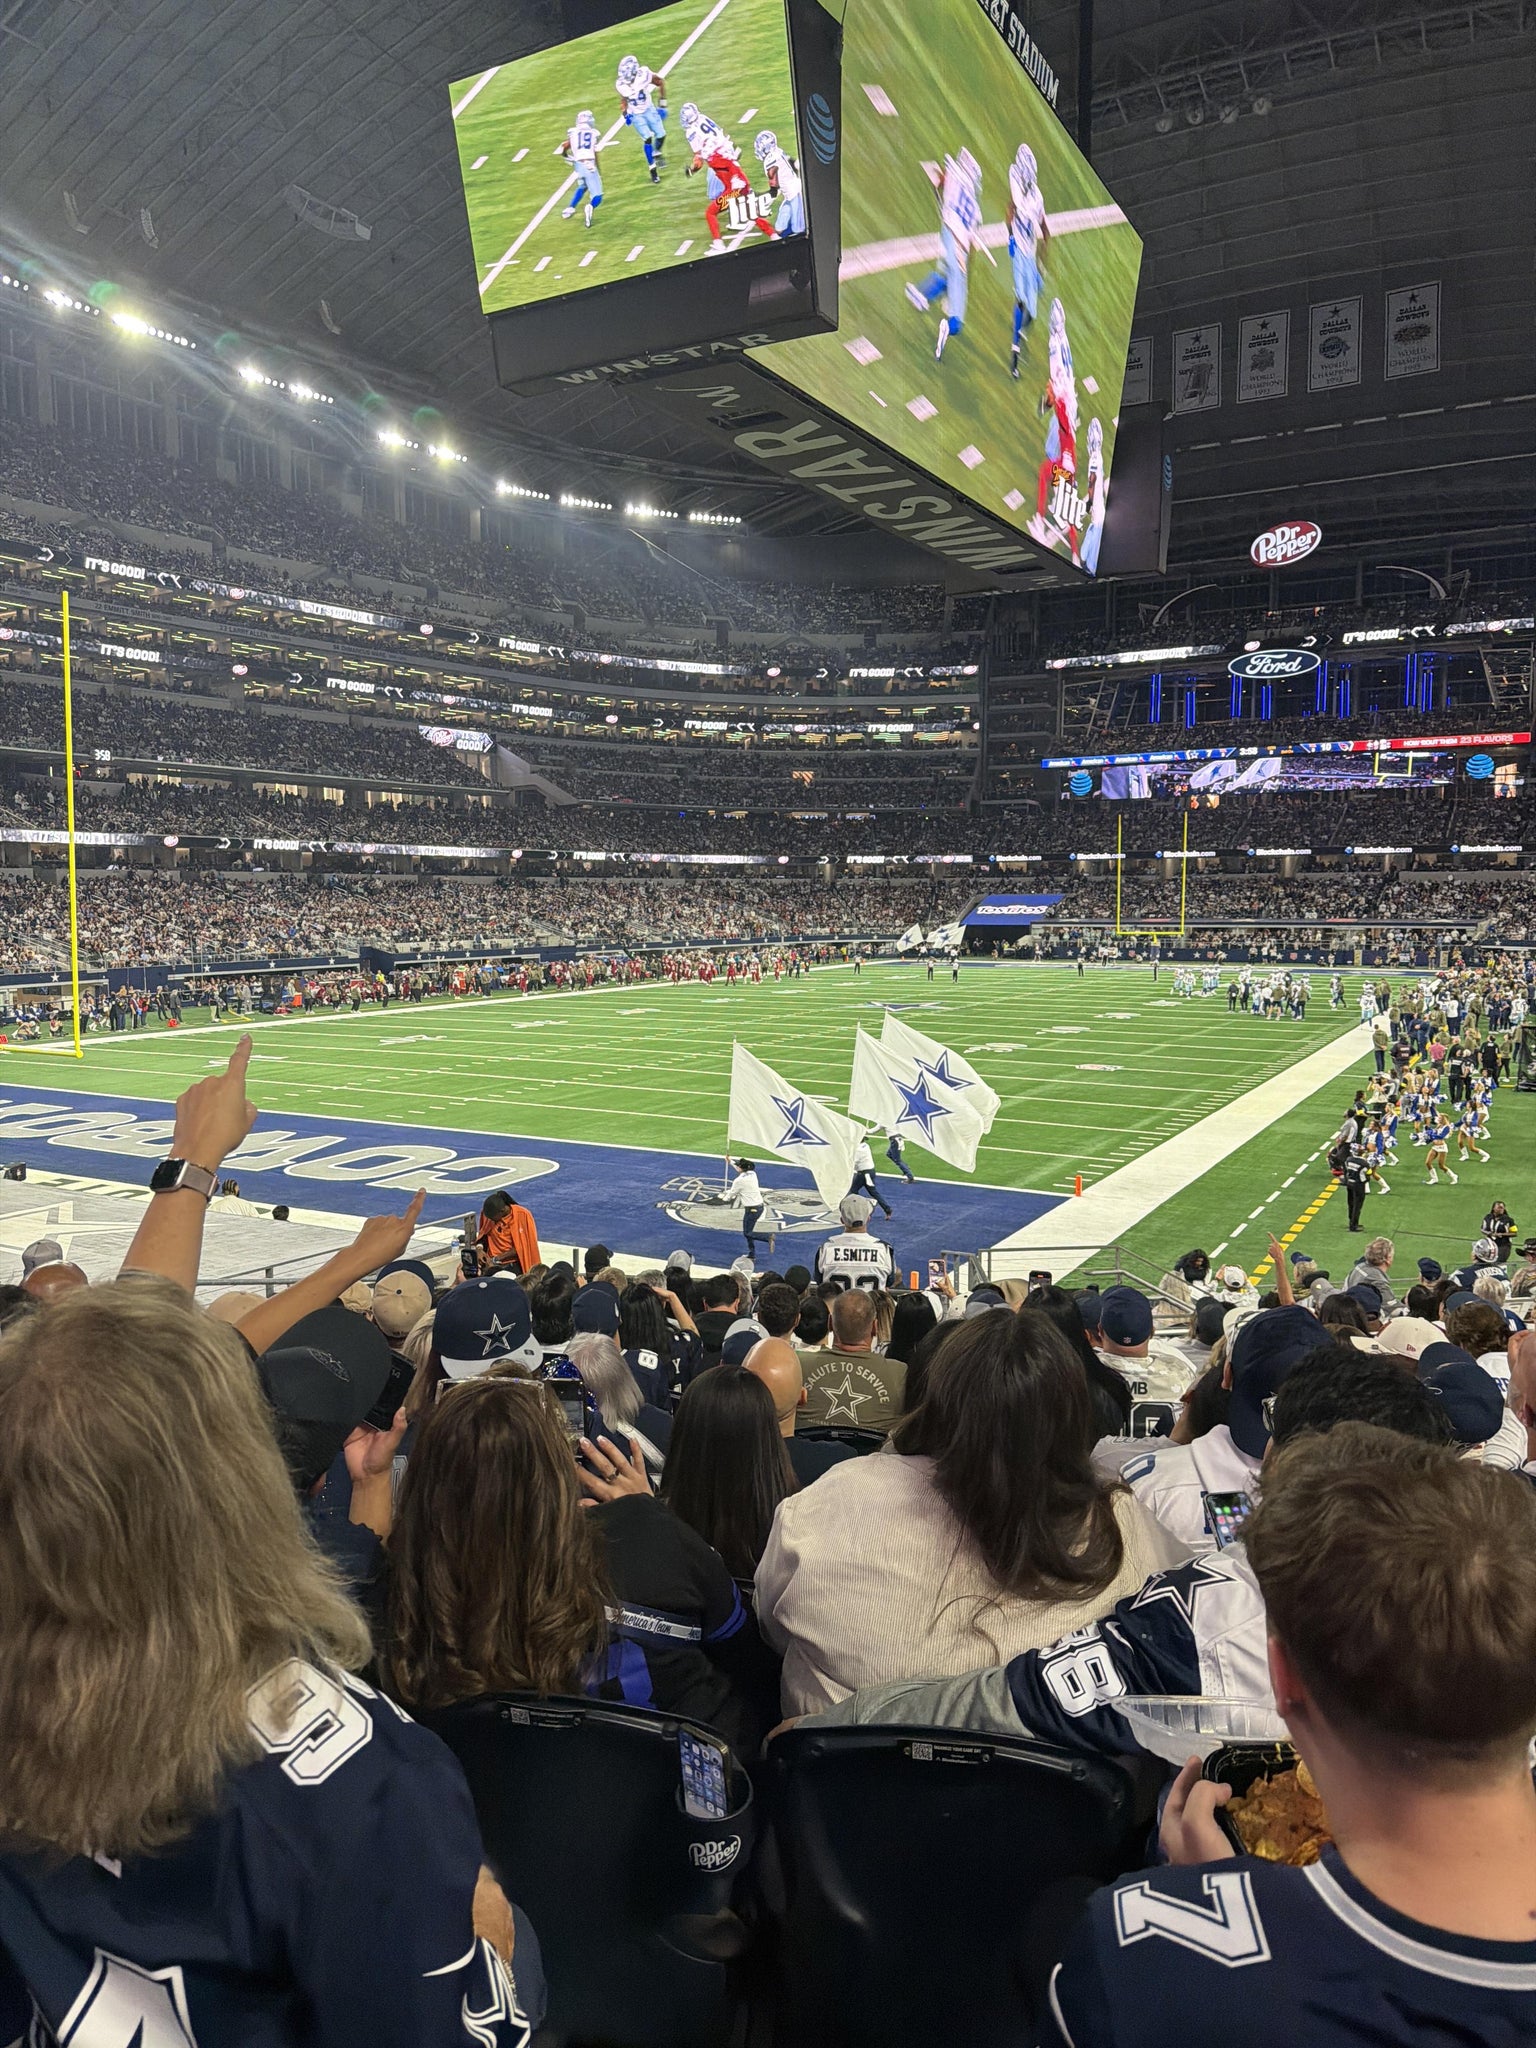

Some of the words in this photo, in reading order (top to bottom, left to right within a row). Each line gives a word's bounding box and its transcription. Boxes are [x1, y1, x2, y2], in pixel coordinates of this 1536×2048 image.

[1007, 11, 1060, 109] STADIUM
[577, 132, 592, 149] 19
[555, 333, 776, 385] WINSTAR
[734, 419, 1038, 570] WINSTAR
[1275, 526, 1300, 545] Dr
[1258, 531, 1316, 563] Pepper
[85, 557, 110, 573] IT'S
[111, 563, 146, 580] GOOD!
[1342, 632, 1366, 644] IT'S
[1366, 628, 1400, 642] GOOD!
[100, 643, 125, 657] IT'S
[126, 647, 161, 662] GOOD!
[499, 637, 516, 649] IT'S
[516, 641, 540, 653] GOOD!
[849, 668, 868, 677] IT'S
[868, 668, 895, 677] GOOD!
[1245, 654, 1301, 674] Ford
[326, 677, 348, 689] IT'S
[348, 680, 375, 694] GOOD!
[512, 704, 529, 713] IT'S
[529, 707, 553, 717] GOOD!
[684, 720, 702, 729] IT'S
[702, 721, 728, 730] GOOD!
[868, 724, 887, 732] IT'S
[887, 723, 914, 732] GOOD!
[456, 740, 483, 751] GOOD!
[1460, 736, 1472, 744] 23
[1473, 734, 1513, 743] FLAVORS
[1239, 747, 1258, 756] 3:58
[1321, 743, 1332, 751] 10
[253, 839, 273, 849] IT'S
[273, 839, 300, 850] GOOD!
[1256, 847, 1312, 856] Blockchain.com
[1460, 844, 1523, 852] Blockchain.com
[834, 1248, 878, 1262] E.SMITH
[804, 1362, 838, 1391] SALUTE
[840, 1362, 853, 1373] TO
[855, 1365, 890, 1404] SERVICE
[652, 1616, 672, 1635] Team
[689, 1843, 738, 1868] Pepper
[705, 1841, 725, 1854] Dr
[1114, 1871, 1271, 1968] 7
